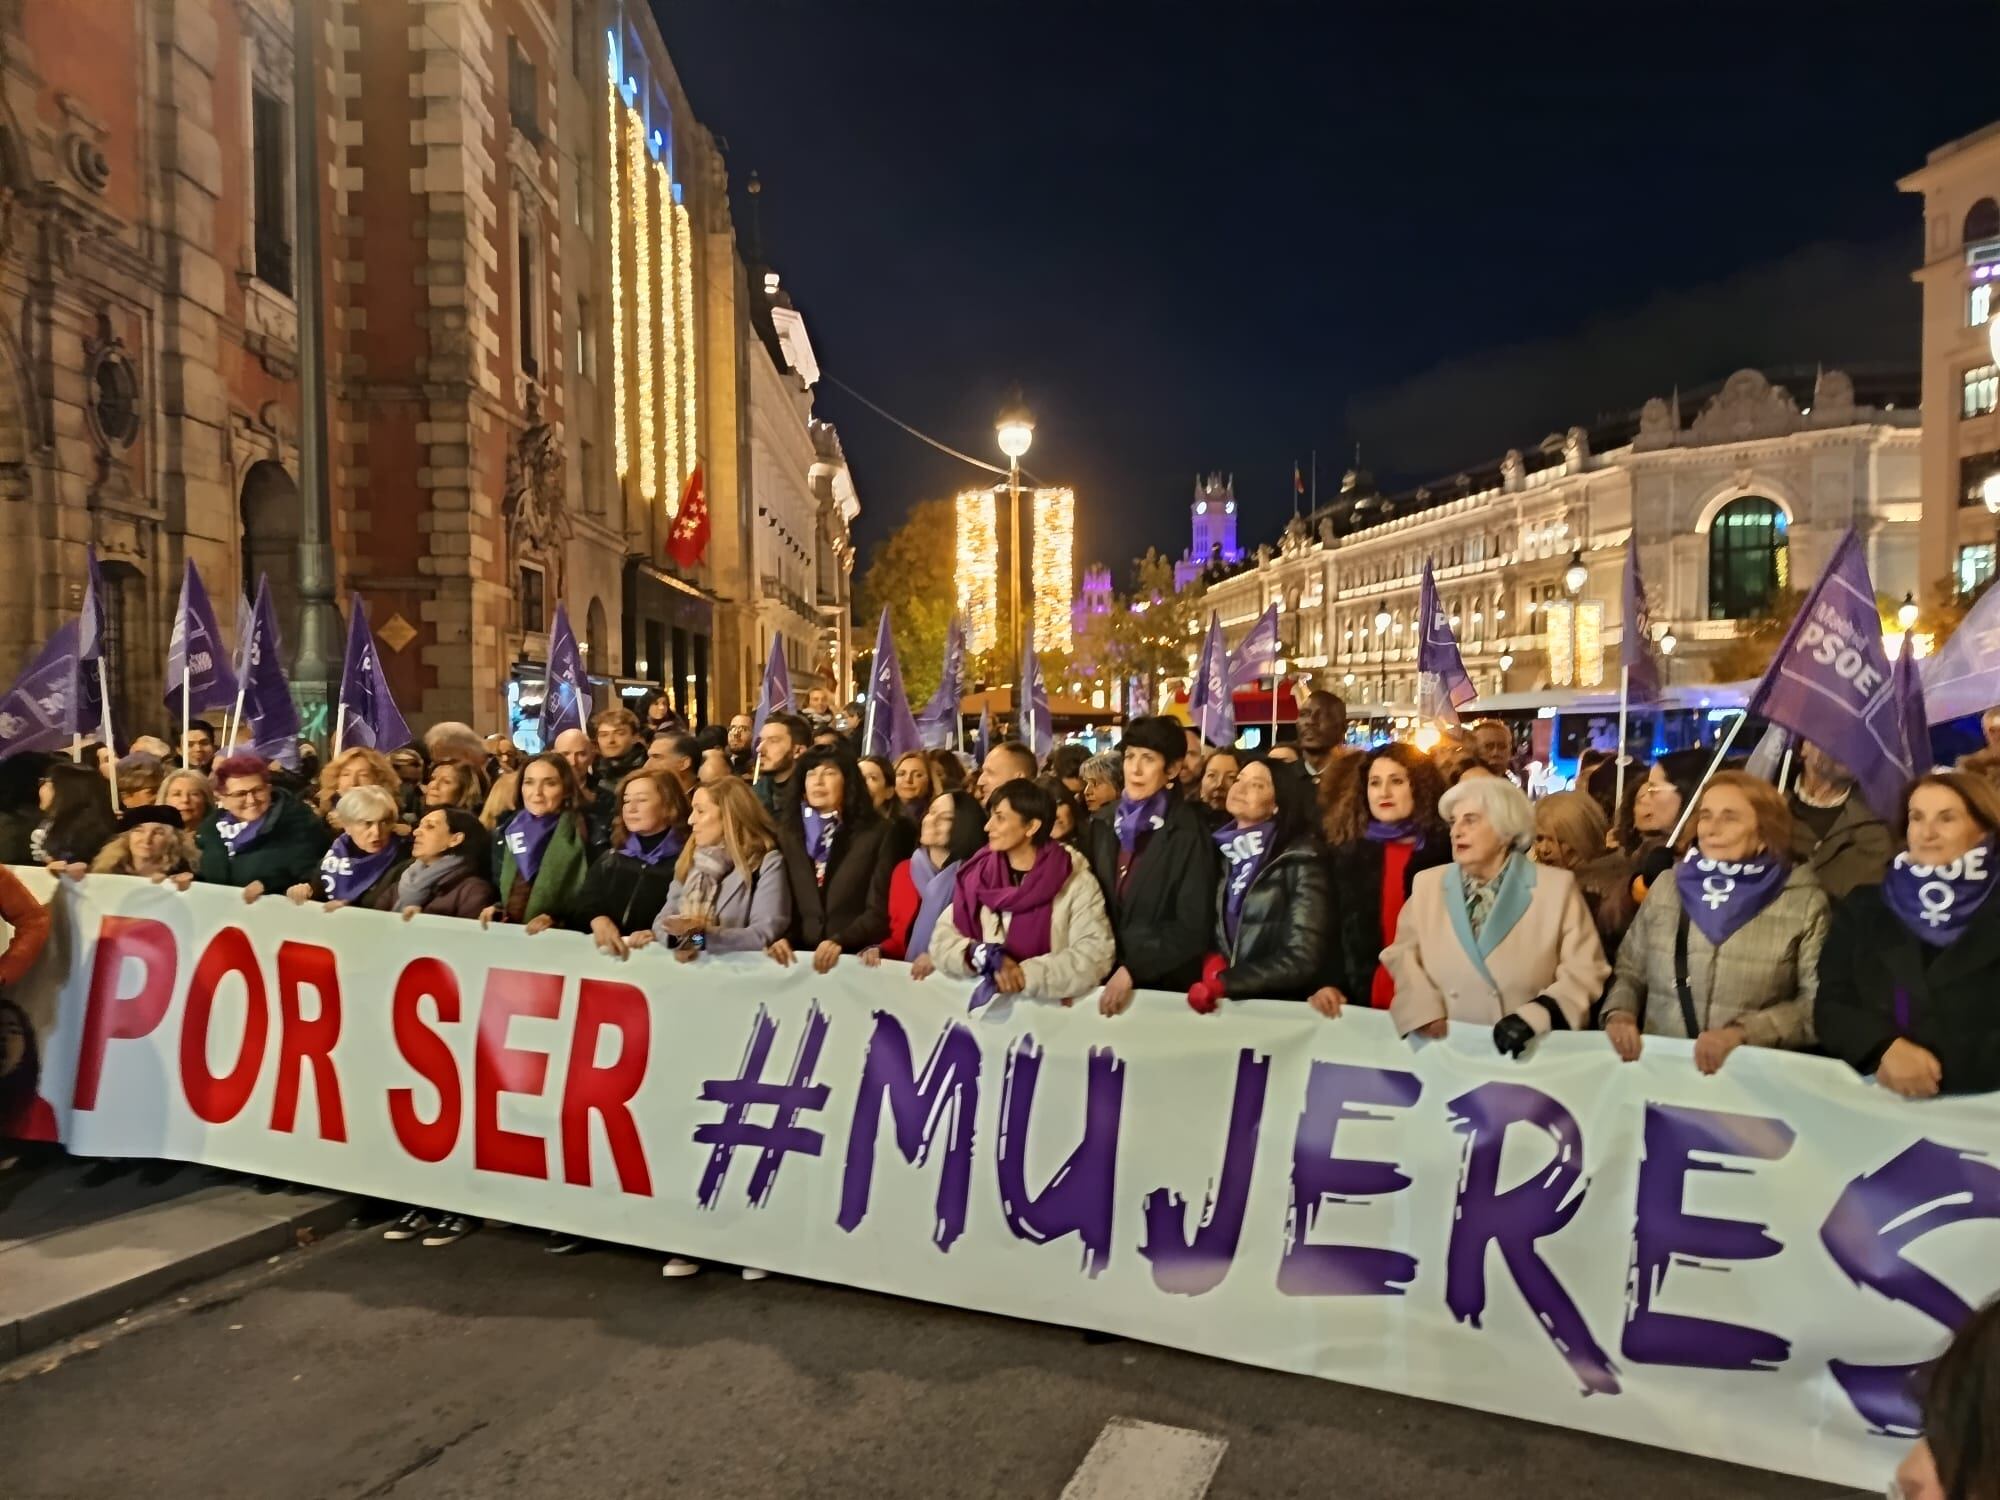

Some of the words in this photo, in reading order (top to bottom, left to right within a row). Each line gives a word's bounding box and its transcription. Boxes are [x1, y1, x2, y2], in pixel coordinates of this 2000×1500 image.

[1795, 621, 1883, 698] PSOE
[72, 915, 347, 1144] POR
[387, 956, 654, 1197] SER
[692, 997, 2000, 1438] #MUJERES
